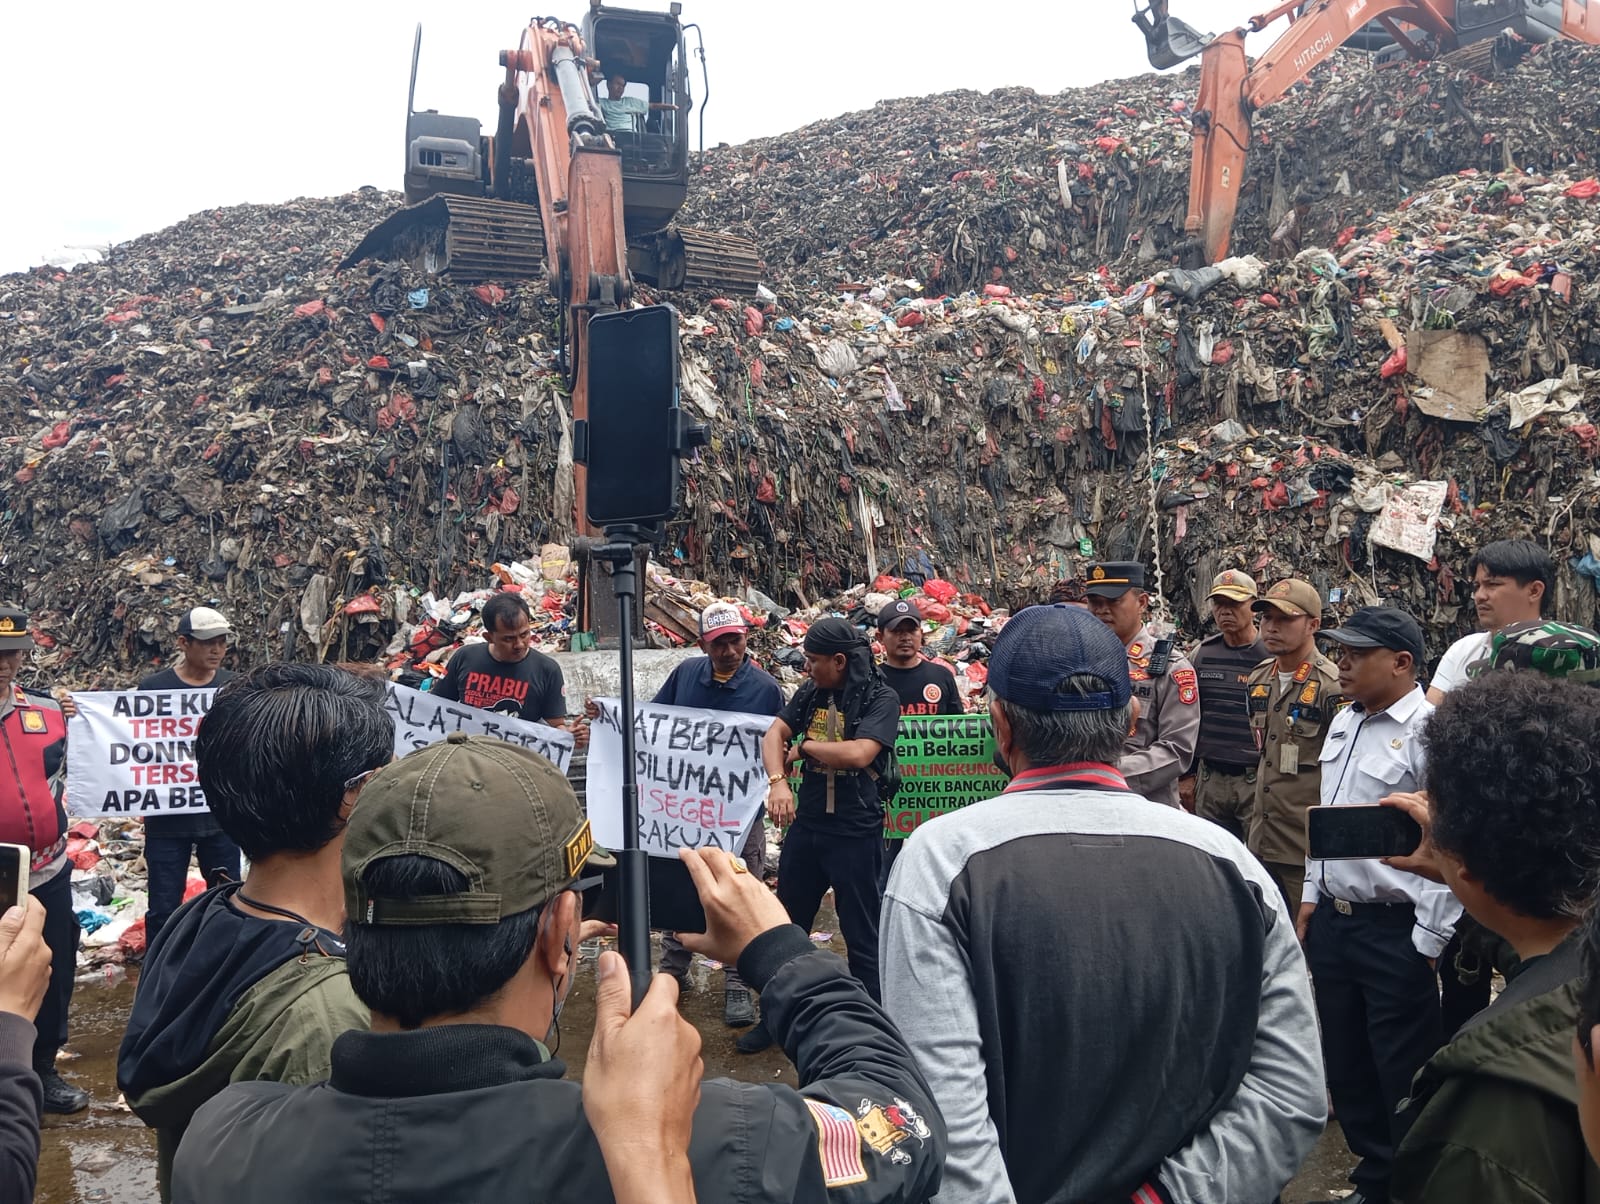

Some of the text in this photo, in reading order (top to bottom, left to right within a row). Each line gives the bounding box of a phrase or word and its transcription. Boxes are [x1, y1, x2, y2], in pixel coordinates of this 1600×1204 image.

[1293, 31, 1334, 71] HITACHI
[464, 671, 529, 700] PRABU
[112, 695, 173, 718] ADE
[384, 686, 473, 734] ALAT
[669, 717, 766, 762] BERAT
[923, 740, 985, 757] Bekasi
[130, 763, 201, 786] TERS
[921, 763, 1004, 777] LINGKUNG
[101, 789, 161, 813] APA
[650, 789, 740, 829] SEGEL
[573, 829, 591, 866] PWI
